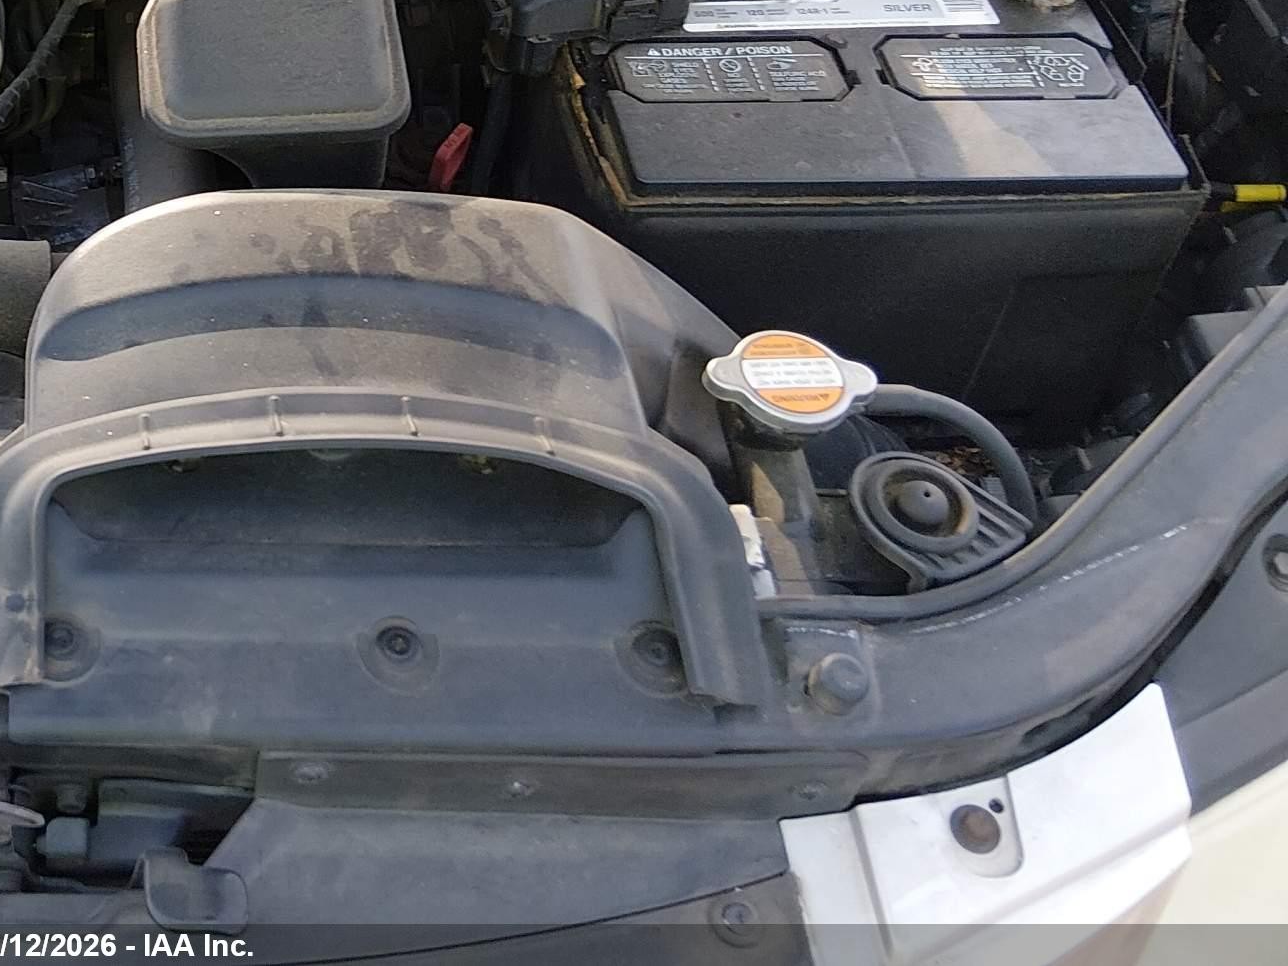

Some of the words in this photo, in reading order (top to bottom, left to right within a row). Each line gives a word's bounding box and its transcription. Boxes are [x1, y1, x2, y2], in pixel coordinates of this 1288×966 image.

[883, 4, 931, 12] SILVER
[662, 48, 722, 57] DANGER
[736, 46, 792, 55] POISON
